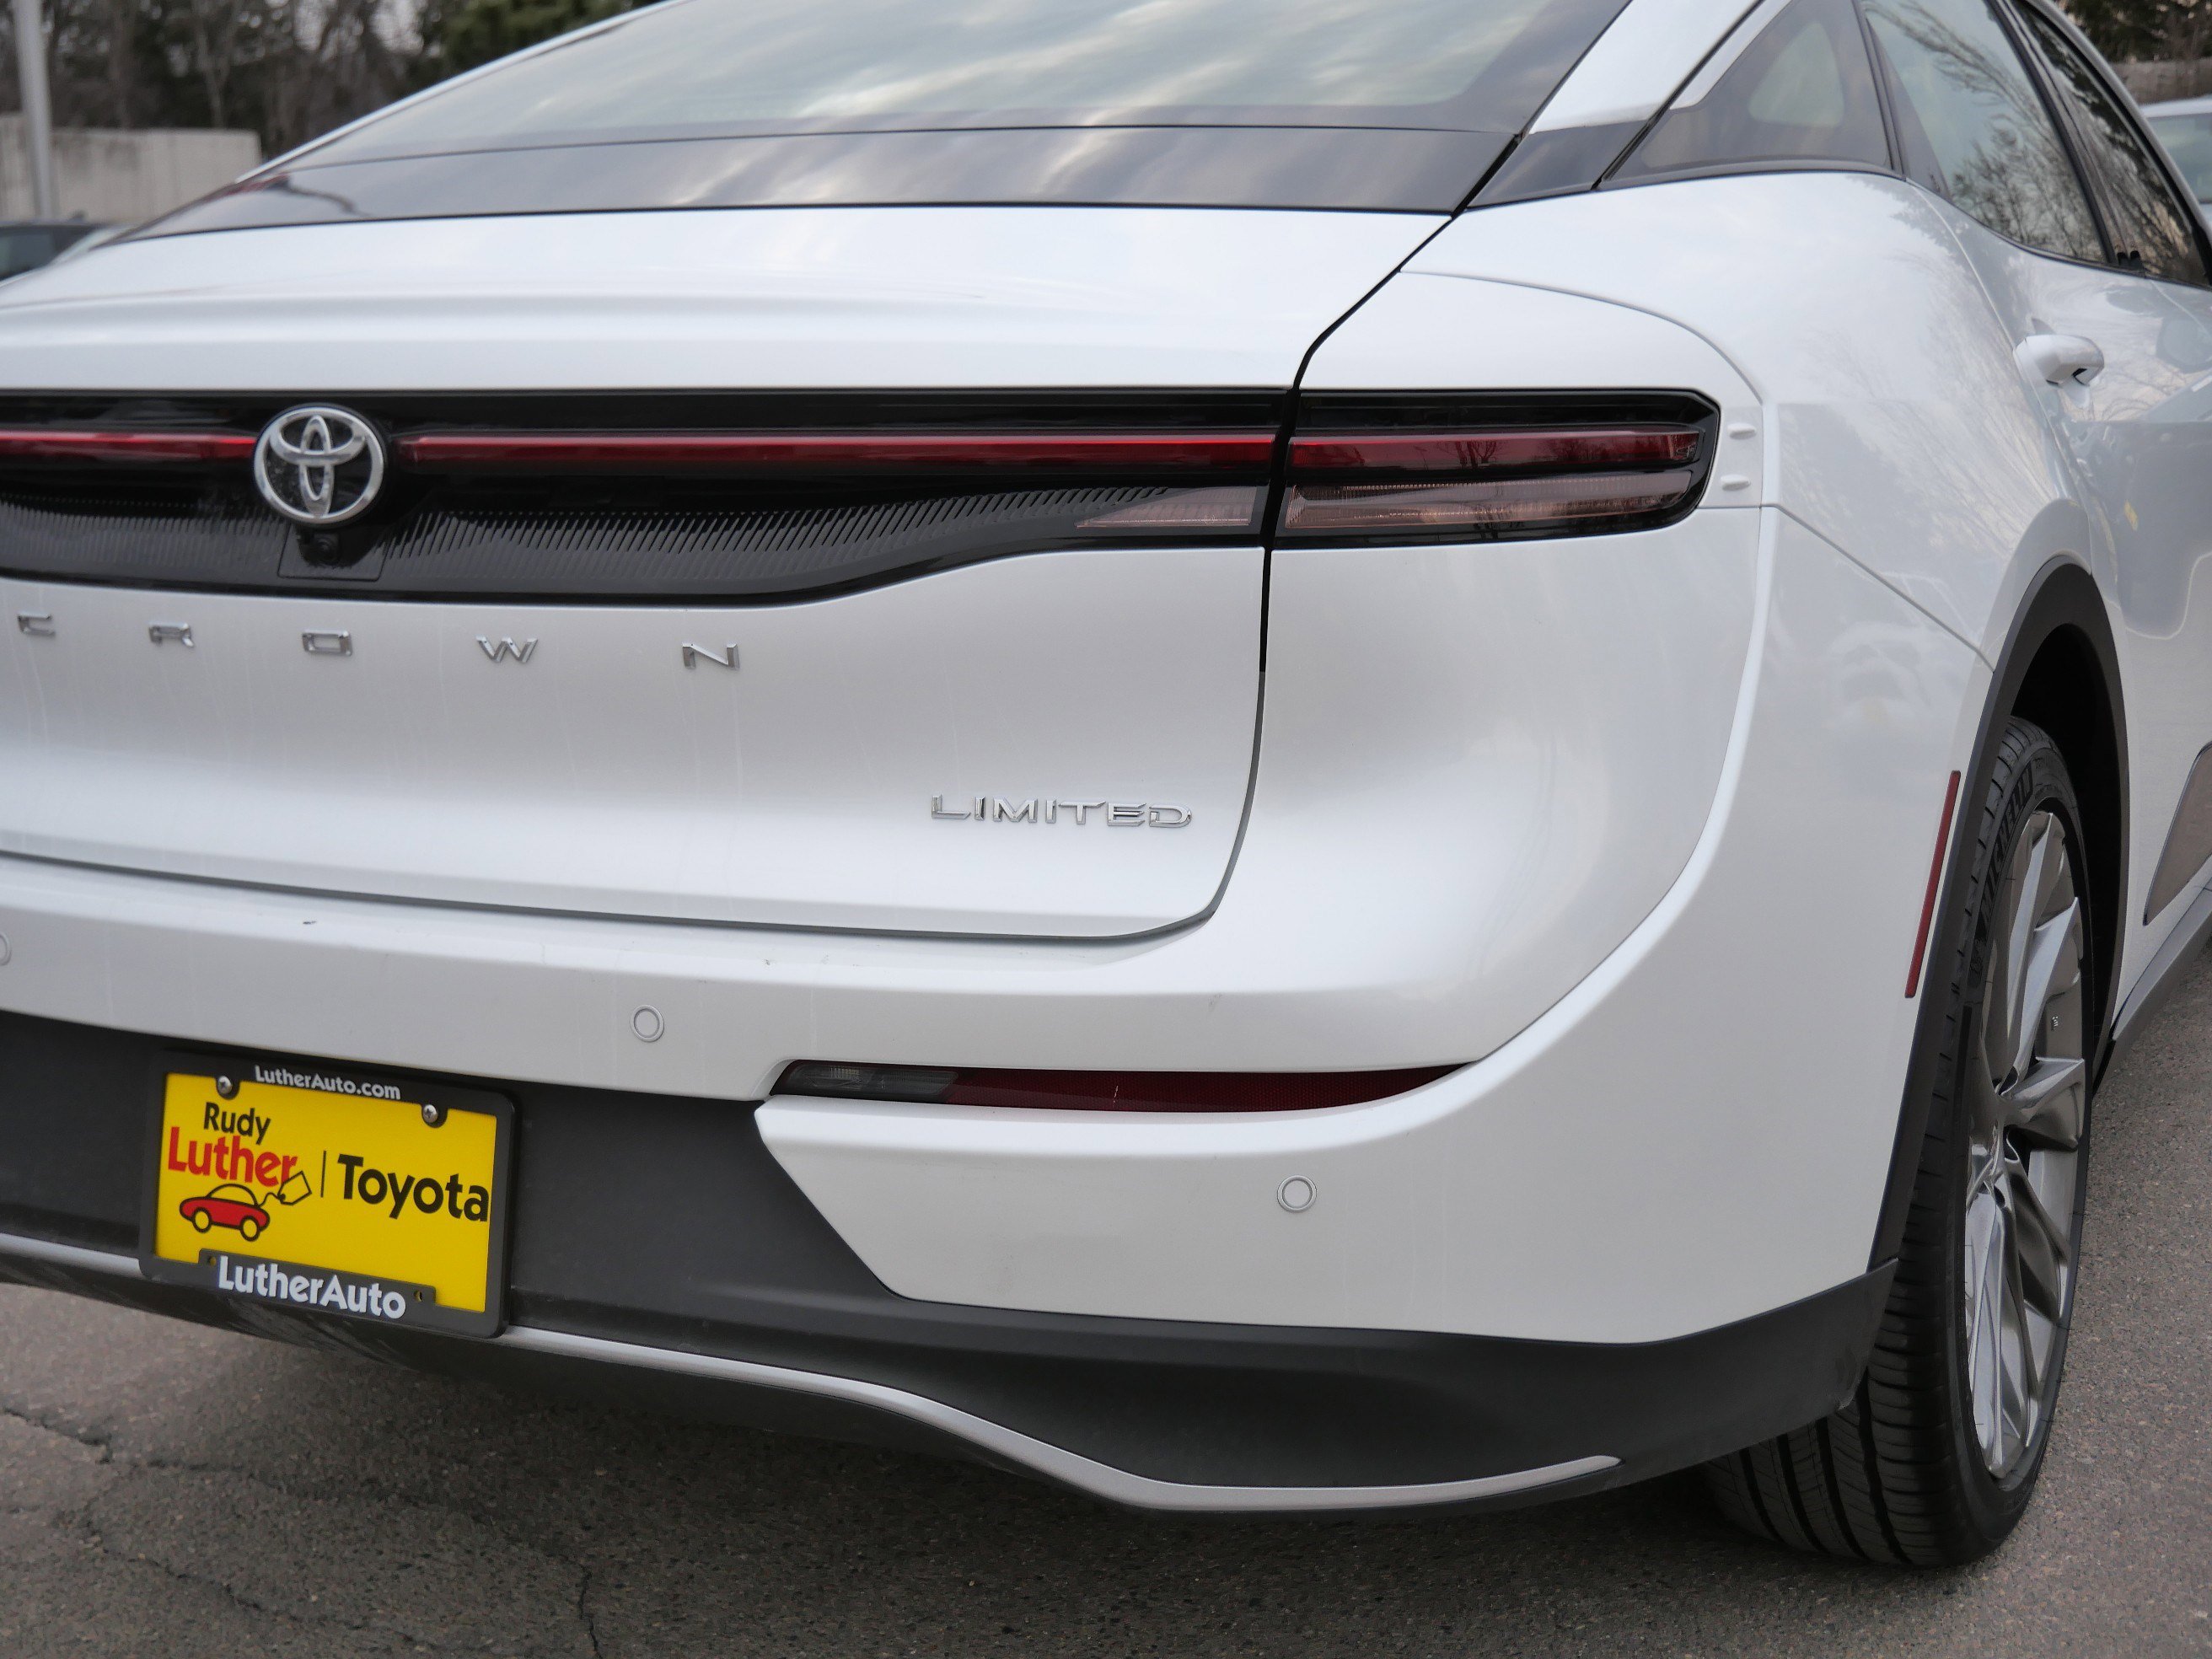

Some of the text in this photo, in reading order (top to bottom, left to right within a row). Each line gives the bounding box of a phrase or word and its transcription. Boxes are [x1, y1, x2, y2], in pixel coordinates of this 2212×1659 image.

[17, 613, 739, 671] CROWN
[932, 794, 1193, 828] LIMITED
[255, 1066, 401, 1100] LutherAuto.com
[204, 1102, 271, 1145] Rudy
[168, 1126, 298, 1188] Luther
[337, 1153, 489, 1222] Toyota
[217, 1255, 406, 1319] LutherAuto
